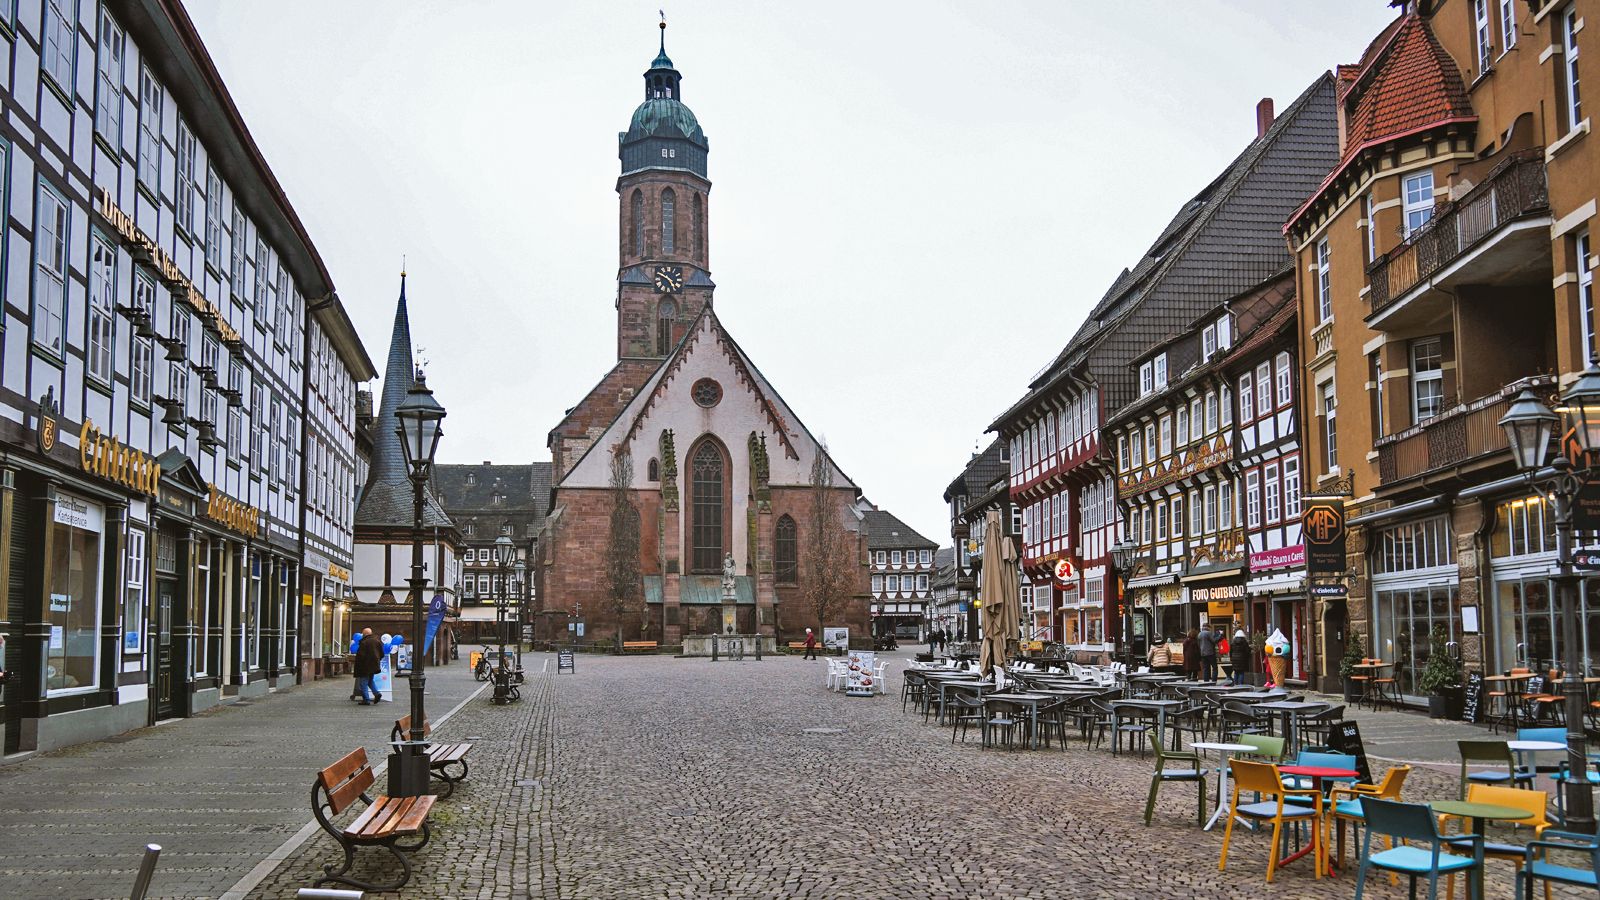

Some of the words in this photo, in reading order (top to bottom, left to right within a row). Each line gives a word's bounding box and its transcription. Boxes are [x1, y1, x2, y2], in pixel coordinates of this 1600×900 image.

[79, 418, 161, 497] Einbecker
[1272, 555, 1287, 565] GELATO
[1192, 588, 1209, 600] FOTO
[1209, 585, 1244, 599] GUTBROD
